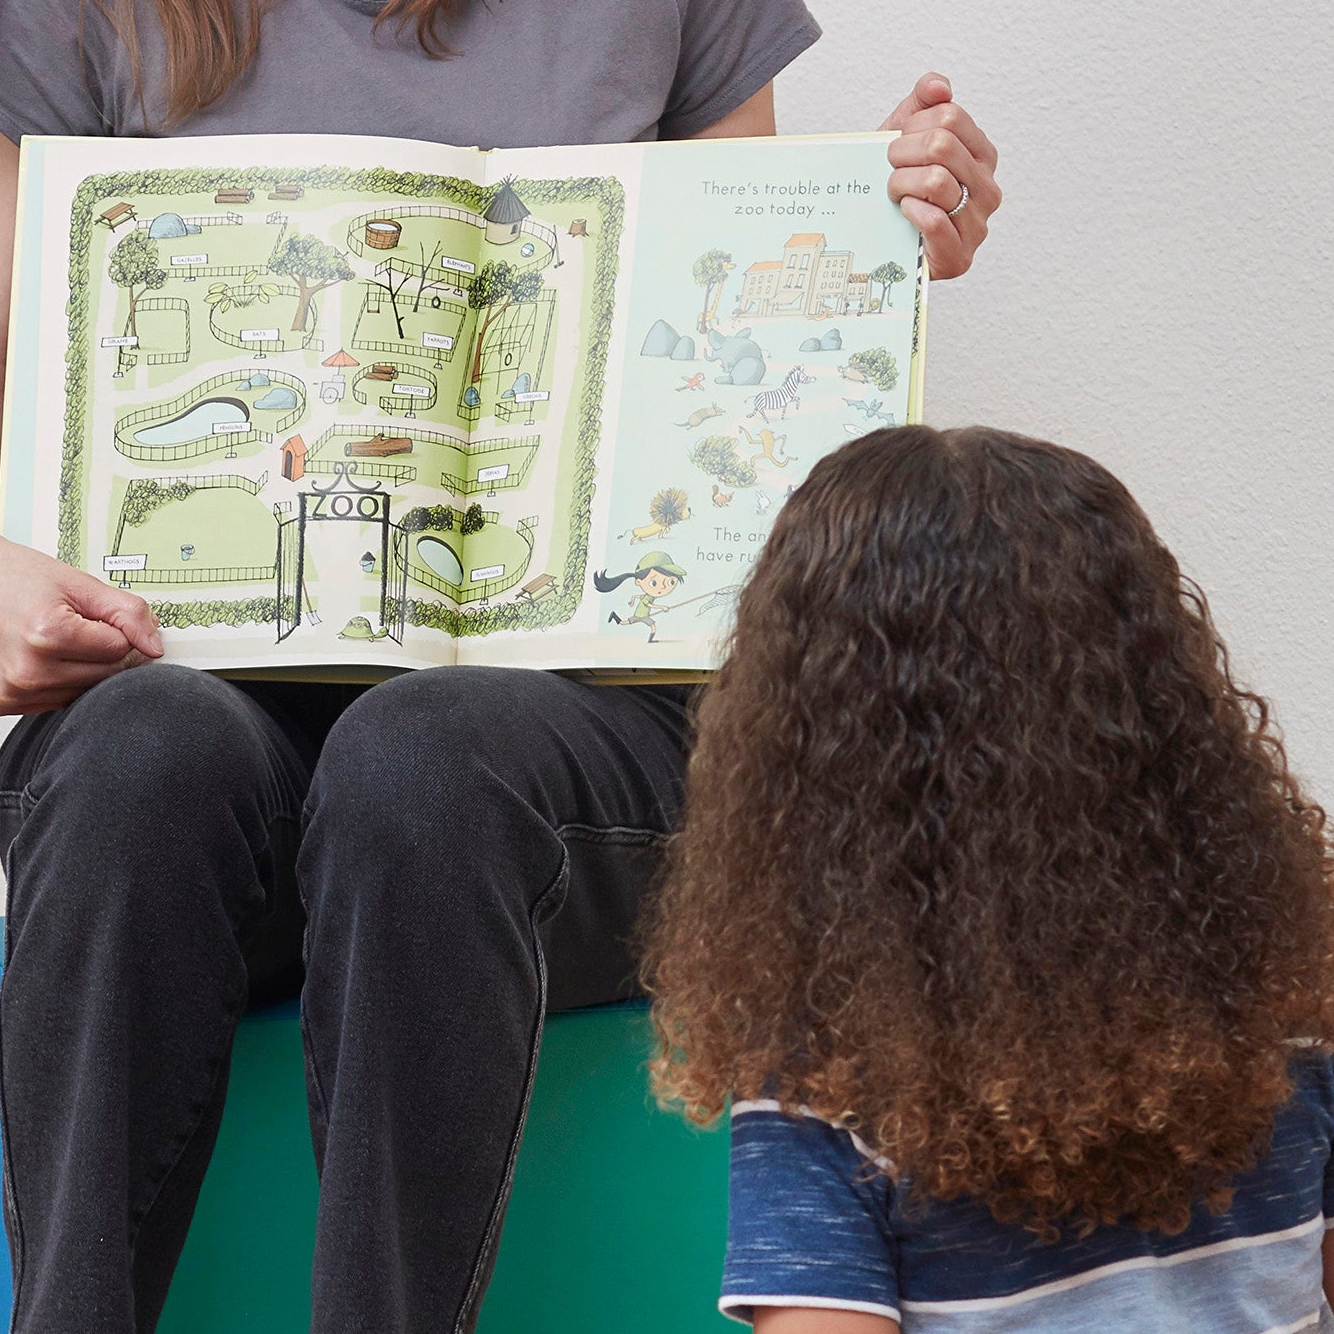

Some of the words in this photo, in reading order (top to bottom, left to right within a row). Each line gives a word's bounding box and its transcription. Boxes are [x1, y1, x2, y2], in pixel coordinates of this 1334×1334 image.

[702, 181, 759, 196] There's
[765, 179, 821, 196] trouble
[826, 182, 841, 195] at
[846, 179, 872, 195] the
[733, 203, 765, 216] zoo
[769, 200, 816, 219] today
[311, 494, 380, 518] ZOO
[713, 526, 742, 542] The
[696, 546, 734, 563] have
